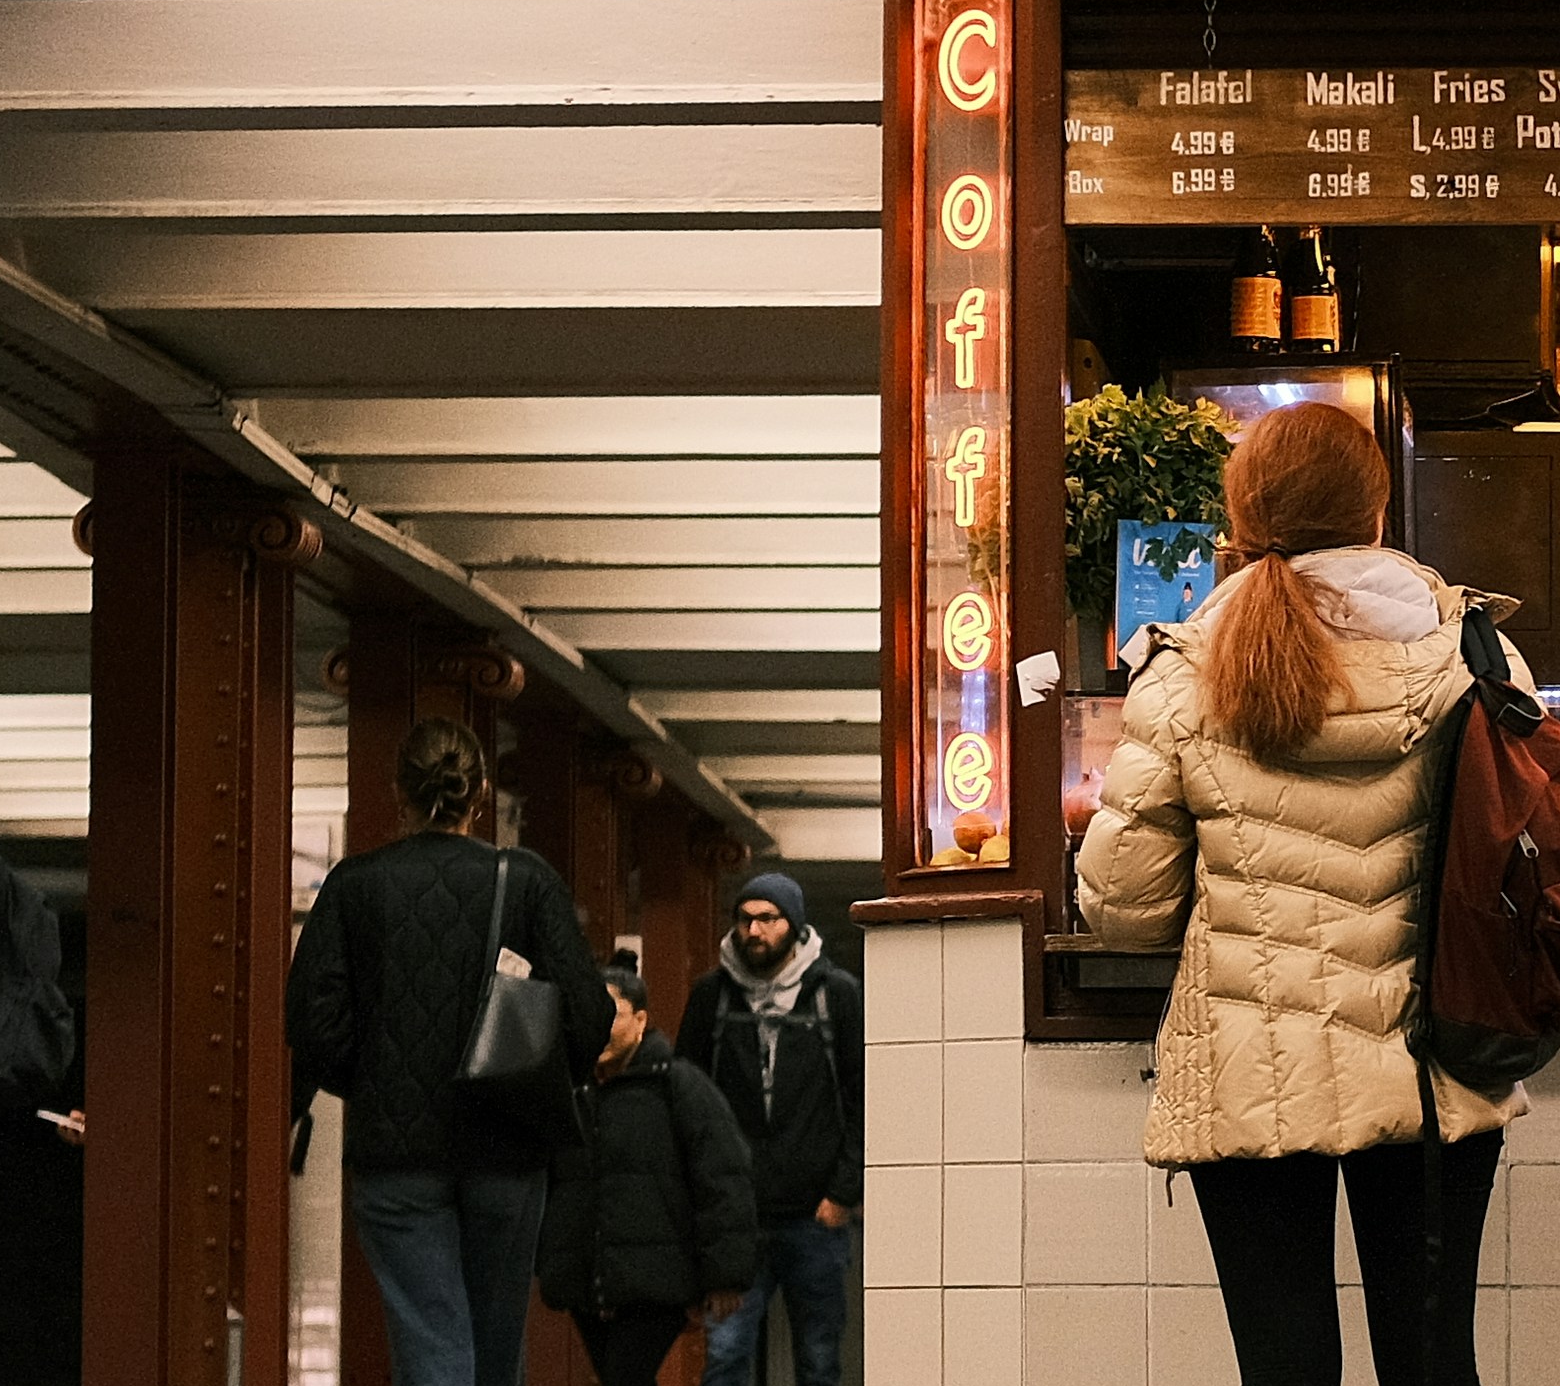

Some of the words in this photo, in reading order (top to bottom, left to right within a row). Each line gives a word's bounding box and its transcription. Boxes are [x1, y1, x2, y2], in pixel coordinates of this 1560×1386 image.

[1159, 69, 1252, 106] Falafel
[1306, 71, 1395, 106] Makali
[1433, 70, 1506, 104] Fries
[1064, 120, 1114, 147] Wrap
[1068, 170, 1104, 195] Box
[938, 9, 996, 811] Coffee
